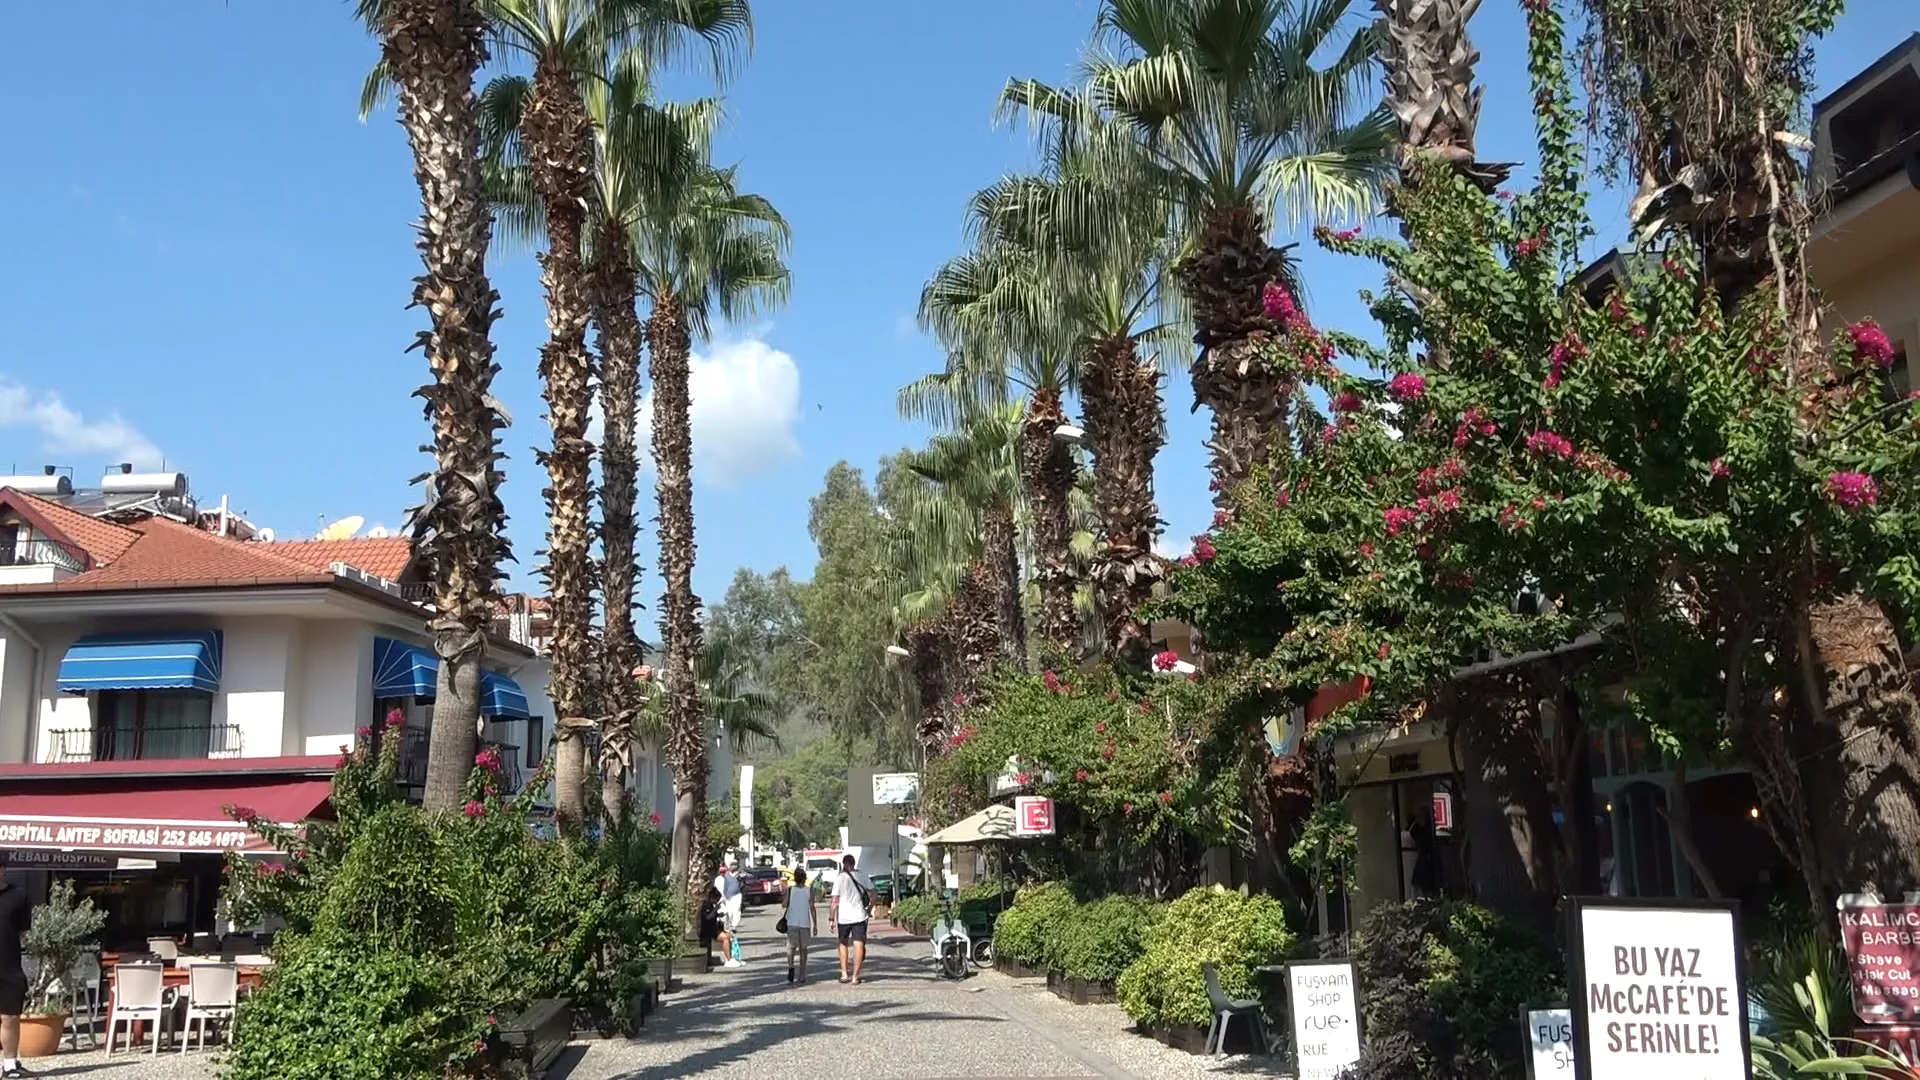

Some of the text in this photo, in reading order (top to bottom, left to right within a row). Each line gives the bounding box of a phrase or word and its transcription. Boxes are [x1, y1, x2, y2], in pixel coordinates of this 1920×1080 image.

[55, 827, 101, 843] ANTEP
[161, 829, 186, 846] 252
[188, 830, 212, 846] 645
[8, 851, 50, 862] KEBAB
[1614, 945, 1702, 978] BU YAZ
[1857, 953, 1903, 966] Shave
[1887, 969, 1912, 980] Cut
[1307, 992, 1341, 1007] SHOP
[1590, 979, 1730, 1016] McCAFÉ'DE
[1303, 1042, 1329, 1056] RUE
